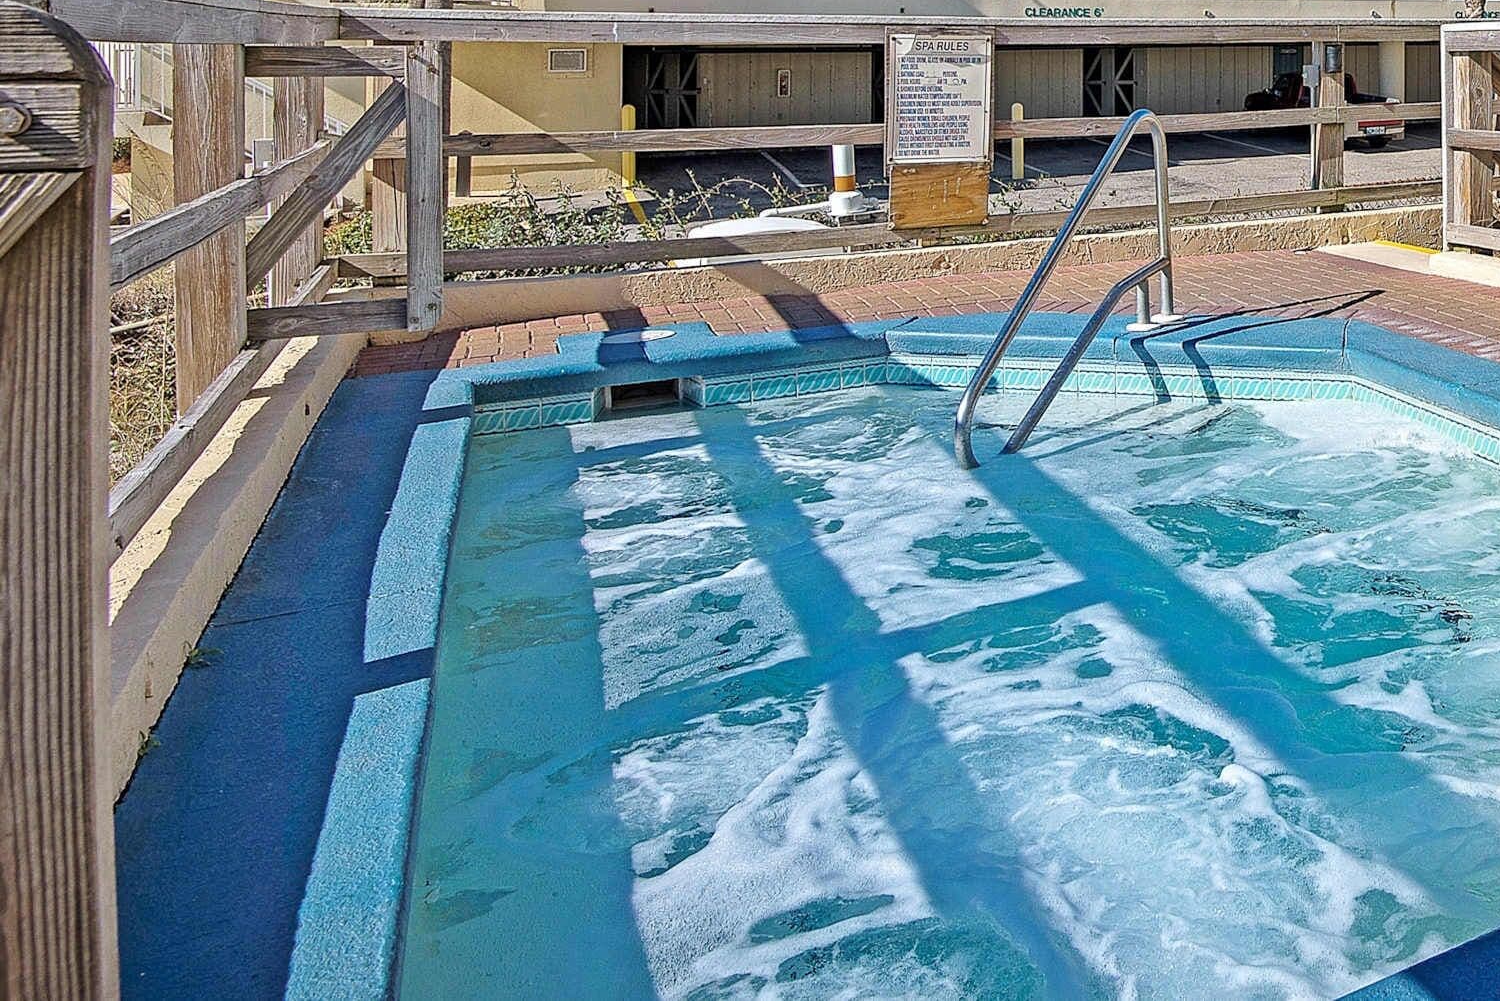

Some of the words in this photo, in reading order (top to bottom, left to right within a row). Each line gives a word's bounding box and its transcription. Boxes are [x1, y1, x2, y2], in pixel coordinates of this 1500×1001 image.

[1024, 7, 1091, 18] CLEARANCE
[1093, 7, 1104, 18] 6'
[915, 41, 934, 51] SPA
[936, 41, 969, 52] RULES
